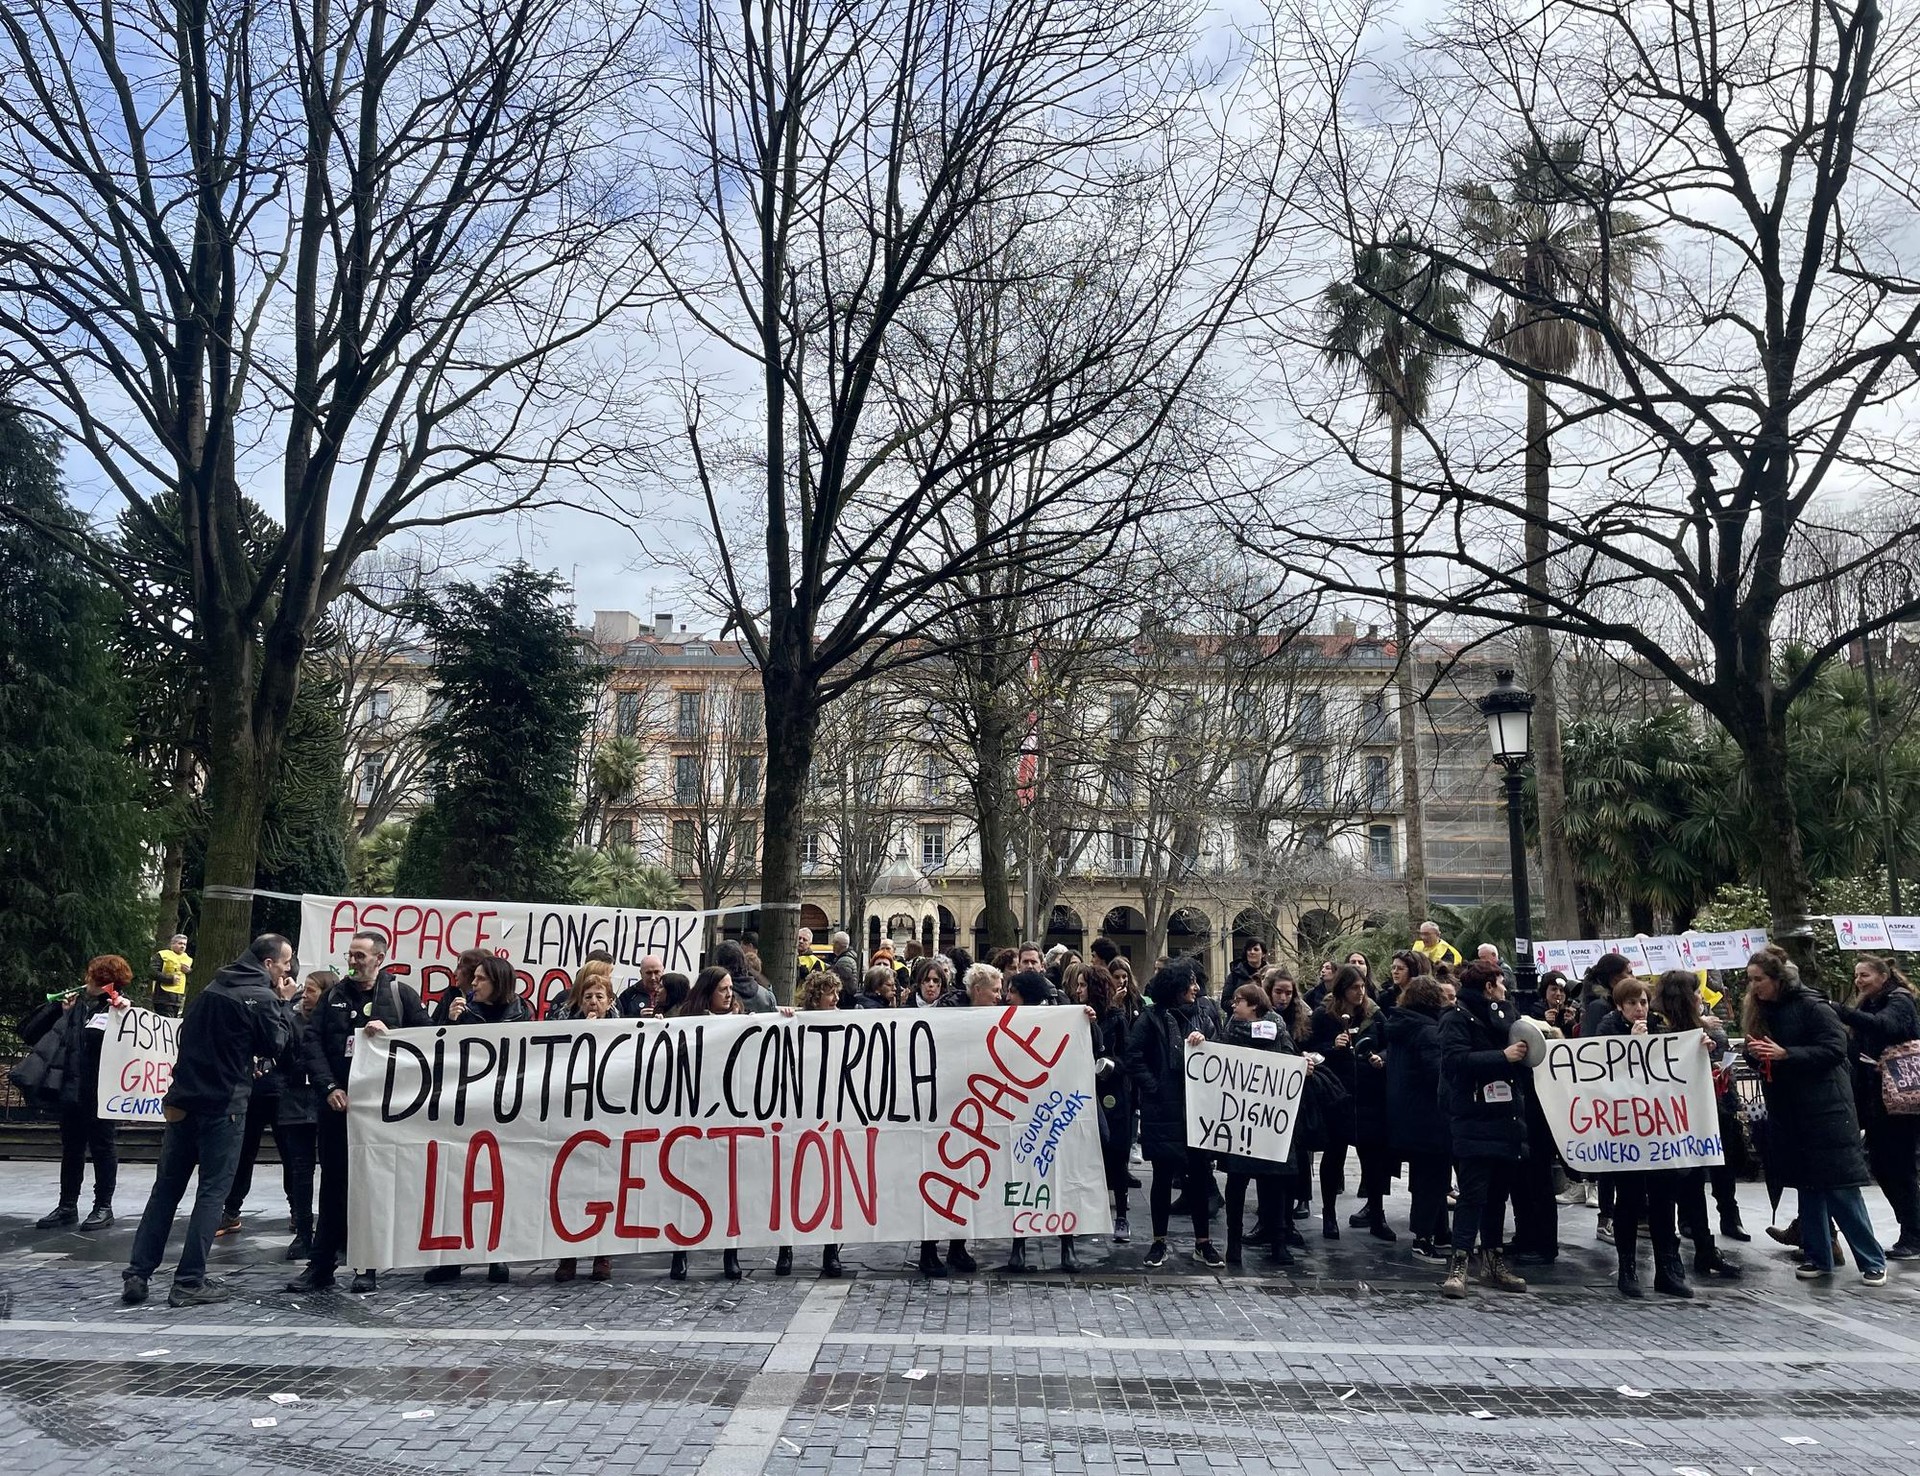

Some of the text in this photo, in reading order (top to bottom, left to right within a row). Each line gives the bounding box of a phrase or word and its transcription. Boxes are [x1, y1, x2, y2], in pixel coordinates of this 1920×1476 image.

[329, 900, 498, 960] ASPACE
[722, 1020, 938, 1126] CONTROLA
[1186, 1051, 1303, 1101] CONVENIO
[1549, 1036, 1687, 1085] ASPACE
[106, 1095, 164, 1115] CENTR
[918, 1005, 1070, 1227] ASPACE
[1220, 1091, 1289, 1134] DIGNO
[1569, 1094, 1690, 1137] GREBAN
[1033, 1089, 1093, 1178] ZENTROAK
[1566, 1133, 1724, 1163] EGUNEKO ZENTROAK
[418, 1130, 505, 1252] LA
[1003, 1181, 1051, 1210] ELA
[1012, 1211, 1077, 1233] CCOO
